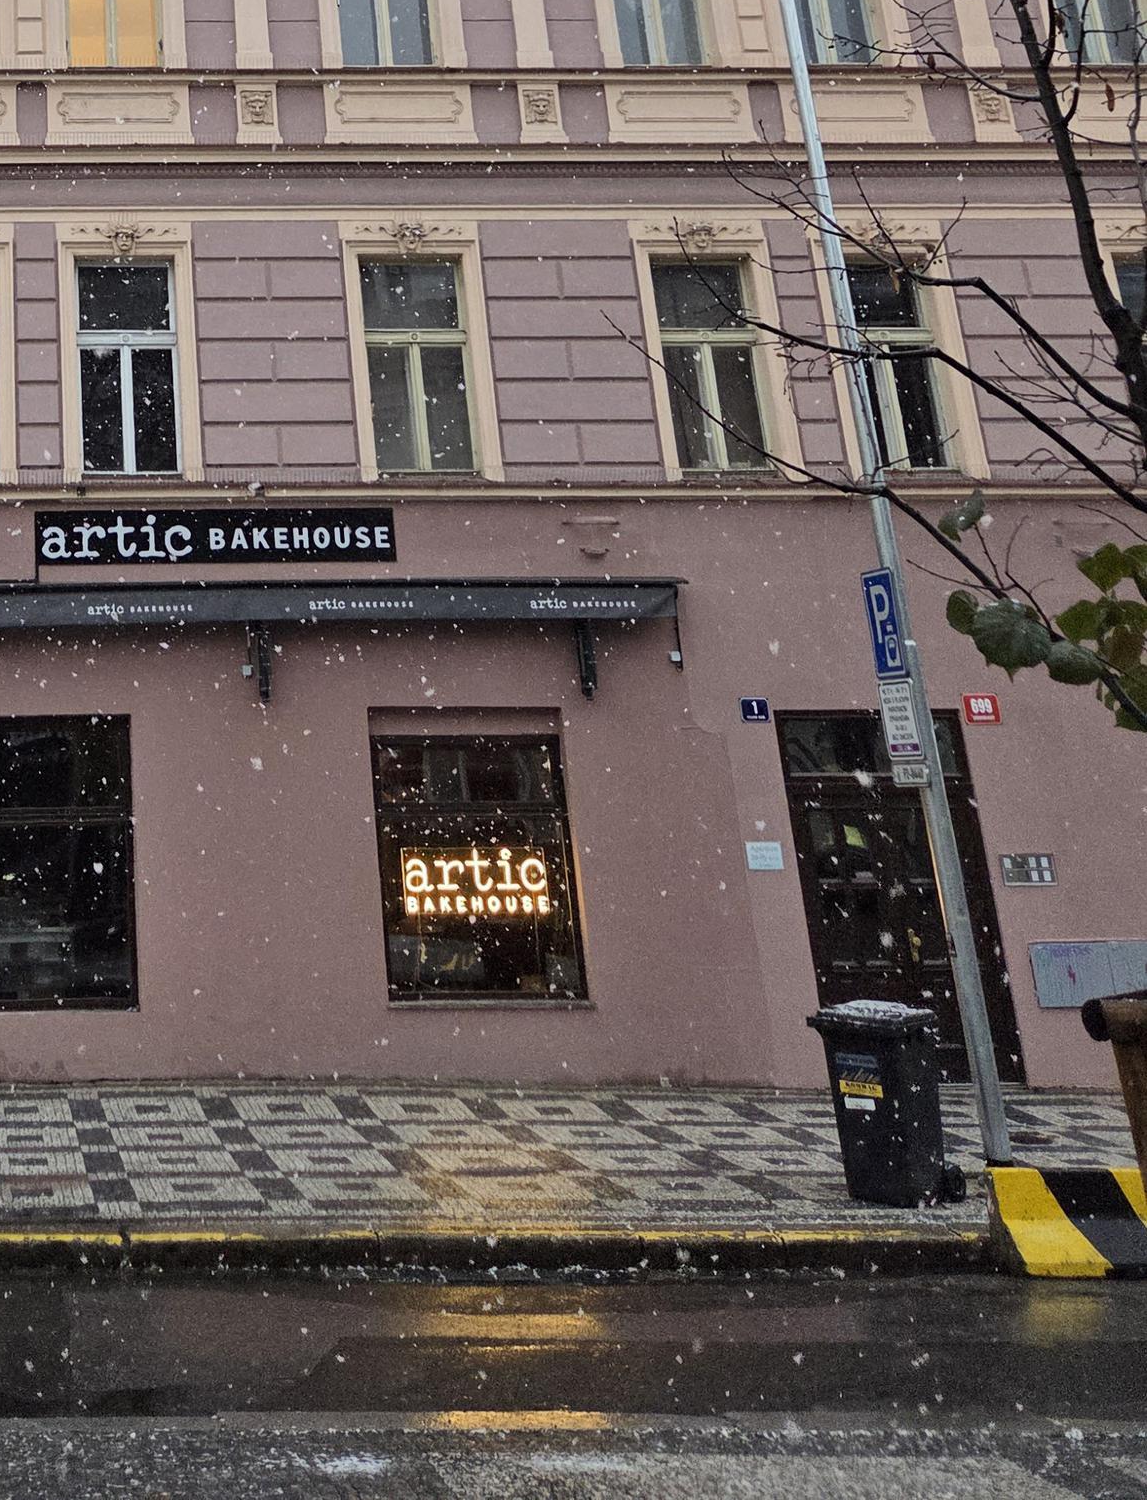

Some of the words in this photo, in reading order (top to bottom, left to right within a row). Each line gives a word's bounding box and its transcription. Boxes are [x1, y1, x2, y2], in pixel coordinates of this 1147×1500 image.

[41, 514, 194, 559] artic
[209, 526, 391, 551] BAKEHOUSE
[87, 604, 124, 616] artic
[130, 604, 193, 612] BAKEHOUSE
[308, 598, 346, 610] artic
[530, 598, 567, 609] artic
[573, 600, 636, 608] BAKEHOUSE
[869, 584, 890, 644] P
[751, 700, 759, 714] 1
[970, 698, 993, 714] 699
[405, 848, 546, 893] artic
[407, 895, 550, 915] BAKEHOUSE
